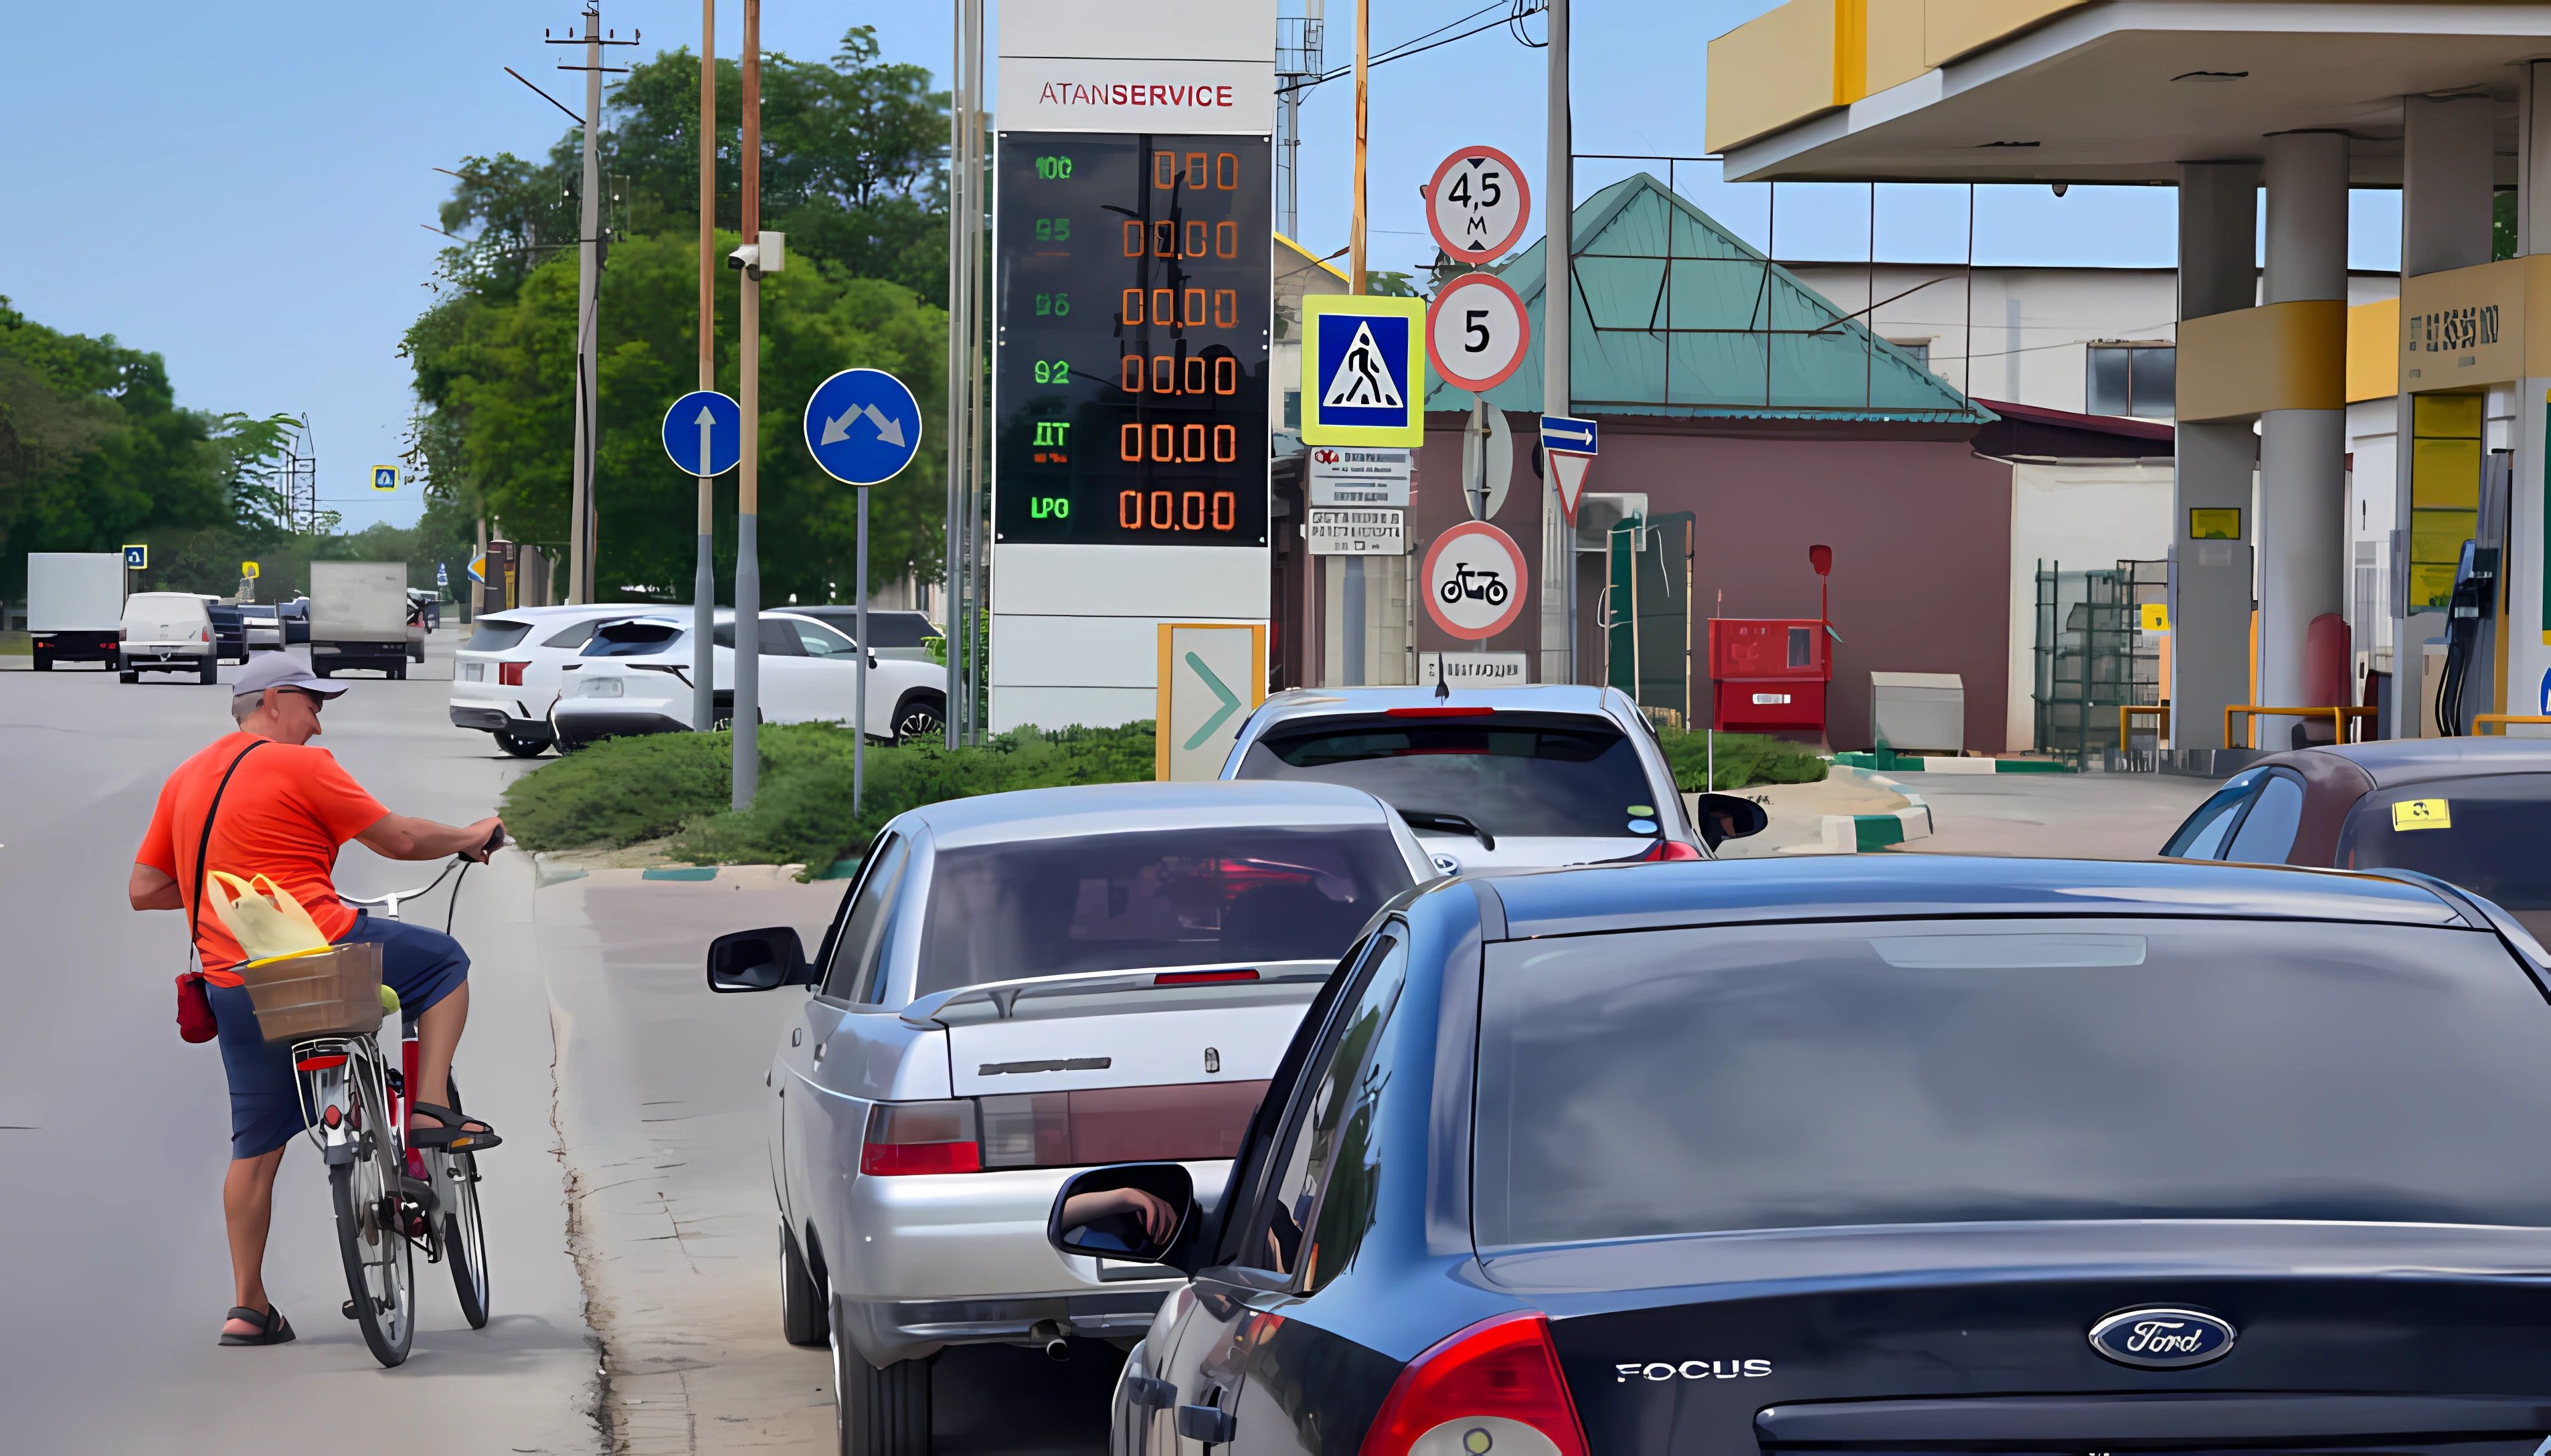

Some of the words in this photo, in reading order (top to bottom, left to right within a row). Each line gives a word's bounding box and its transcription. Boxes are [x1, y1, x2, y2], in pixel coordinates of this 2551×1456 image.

[1039, 81, 1233, 106] ATANSERVICE
[1036, 156, 1071, 179] 100
[1448, 172, 1501, 213] 4,5
[1123, 288, 1239, 328] 00.00
[1465, 310, 1490, 353] 5
[1035, 360, 1069, 383] 92
[1122, 355, 1236, 395] 00.00
[1033, 422, 1070, 446] ДТ
[1121, 423, 1236, 463] 00.00
[1120, 490, 1235, 531] 00.00
[2127, 1322, 2202, 1353] Ford
[1615, 1359, 1772, 1382] FOCUS
